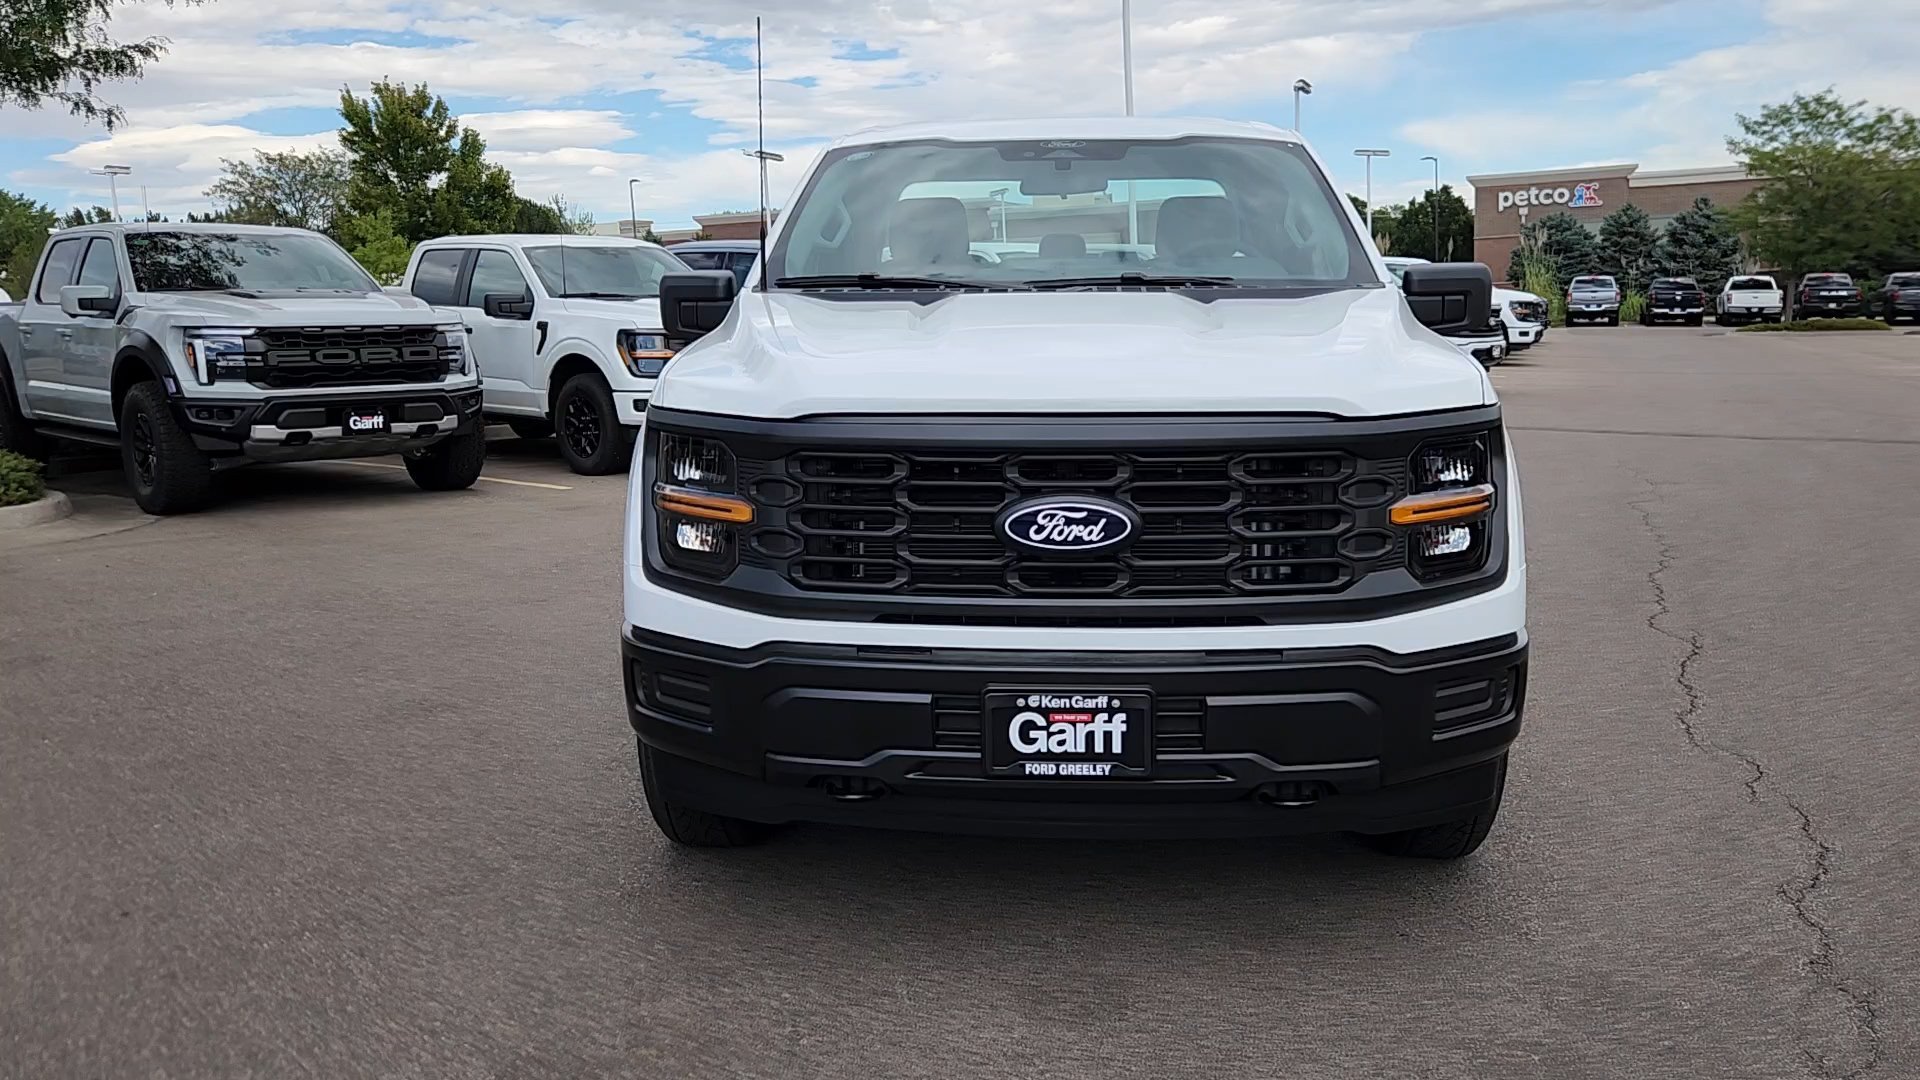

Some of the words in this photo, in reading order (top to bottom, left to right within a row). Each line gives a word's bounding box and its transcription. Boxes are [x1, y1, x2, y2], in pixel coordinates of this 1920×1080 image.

[1498, 187, 1570, 213] petco
[267, 346, 438, 366] FORD
[349, 415, 384, 430] Garff
[1029, 509, 1107, 541] Ford
[1041, 695, 1070, 708] Ken
[1071, 695, 1108, 709] Garff
[1008, 711, 1127, 754] Garff
[1025, 763, 1057, 775] FORD
[1059, 764, 1112, 775] GREELEY
